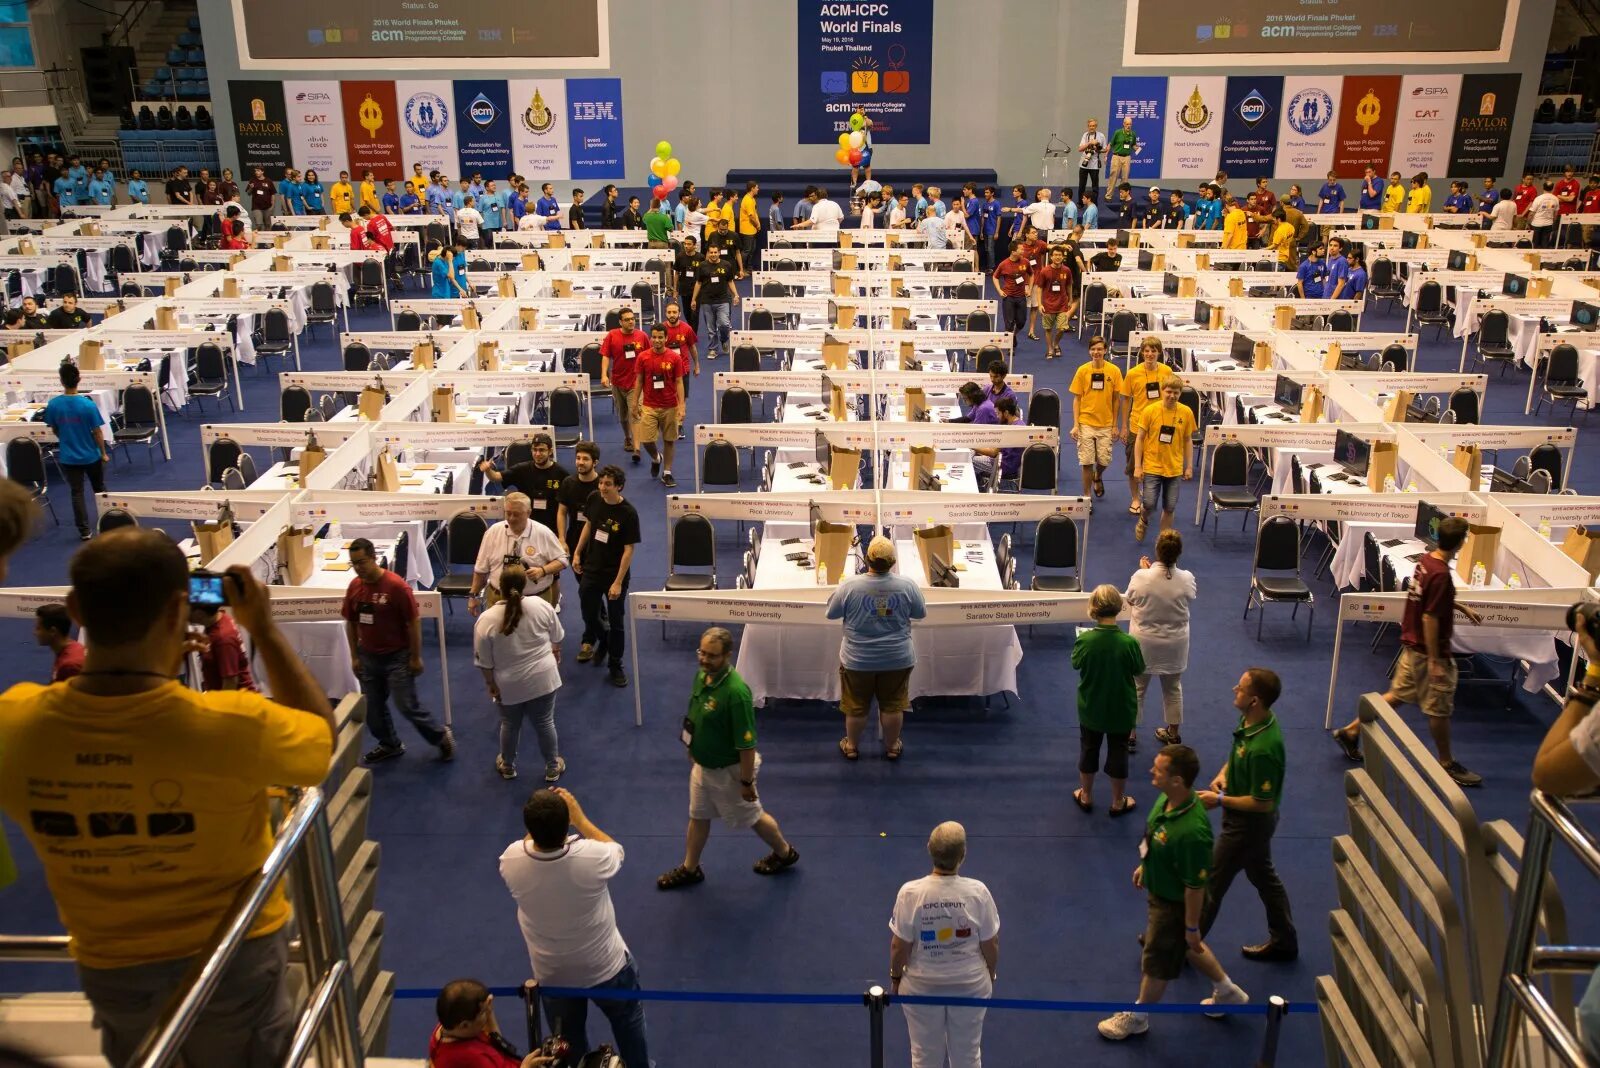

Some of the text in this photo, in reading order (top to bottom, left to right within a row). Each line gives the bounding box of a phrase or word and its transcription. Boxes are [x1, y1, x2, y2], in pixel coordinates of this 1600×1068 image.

[820, 4, 888, 16] ACM-ICPC
[820, 21, 902, 33] World Finals
[1262, 26, 1295, 37] acm
[372, 30, 403, 41] acm
[574, 102, 614, 120] IBM
[826, 103, 850, 112] acm
[1116, 100, 1157, 118] IBM
[240, 123, 283, 132] BAYLOR
[1462, 118, 1507, 127] BAYLOR
[747, 610, 782, 619] University
[1016, 611, 1051, 619] University
[1497, 615, 1518, 623] Tokyo
